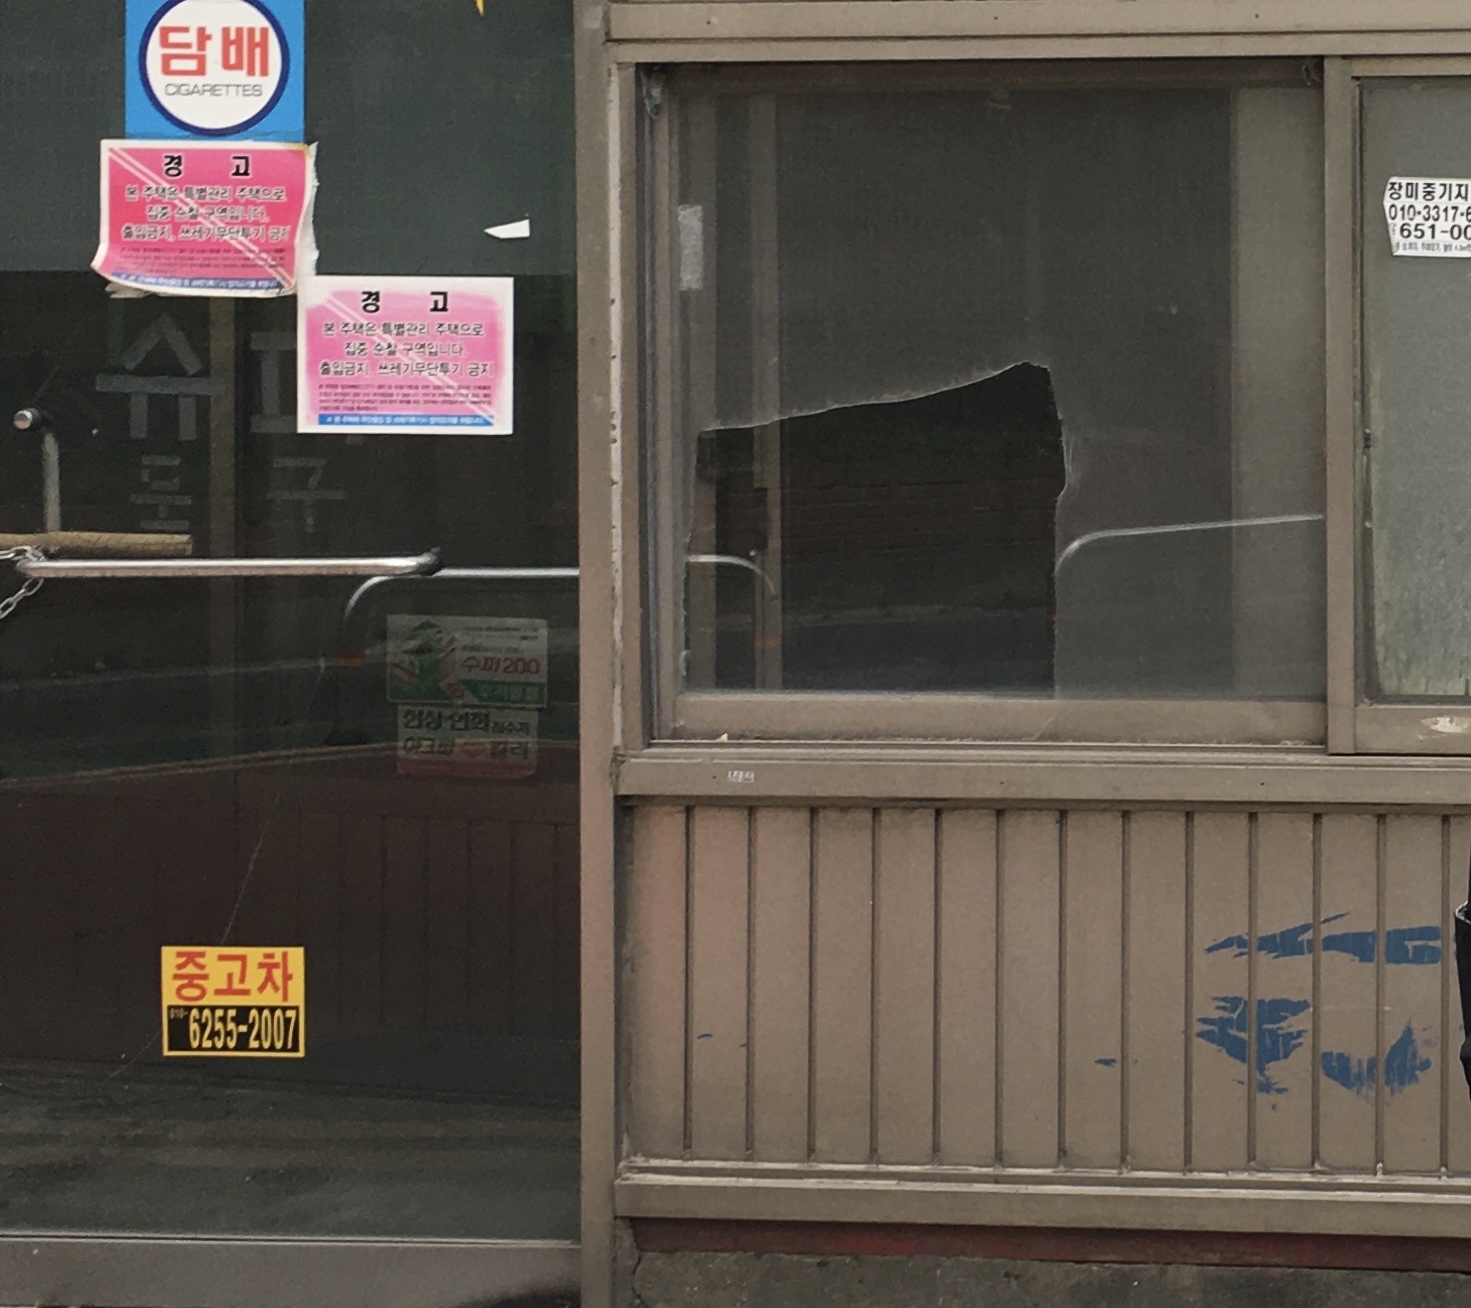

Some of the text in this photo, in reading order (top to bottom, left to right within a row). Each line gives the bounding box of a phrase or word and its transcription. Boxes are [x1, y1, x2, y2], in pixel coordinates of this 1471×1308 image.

[160, 26, 269, 76] 담배
[165, 83, 263, 97] CIGARETTES
[164, 155, 250, 177] 경 고
[236, 186, 285, 201] 주택으로
[361, 291, 449, 313] 경 고
[323, 322, 483, 336] 본 주택은 특별관리 주택으로
[344, 342, 367, 356] 집중
[378, 362, 462, 376] 쓰레기무단투기
[468, 362, 493, 376] 금지
[172, 951, 293, 1002] 중고차
[189, 1008, 297, 1050] 6255-2007
